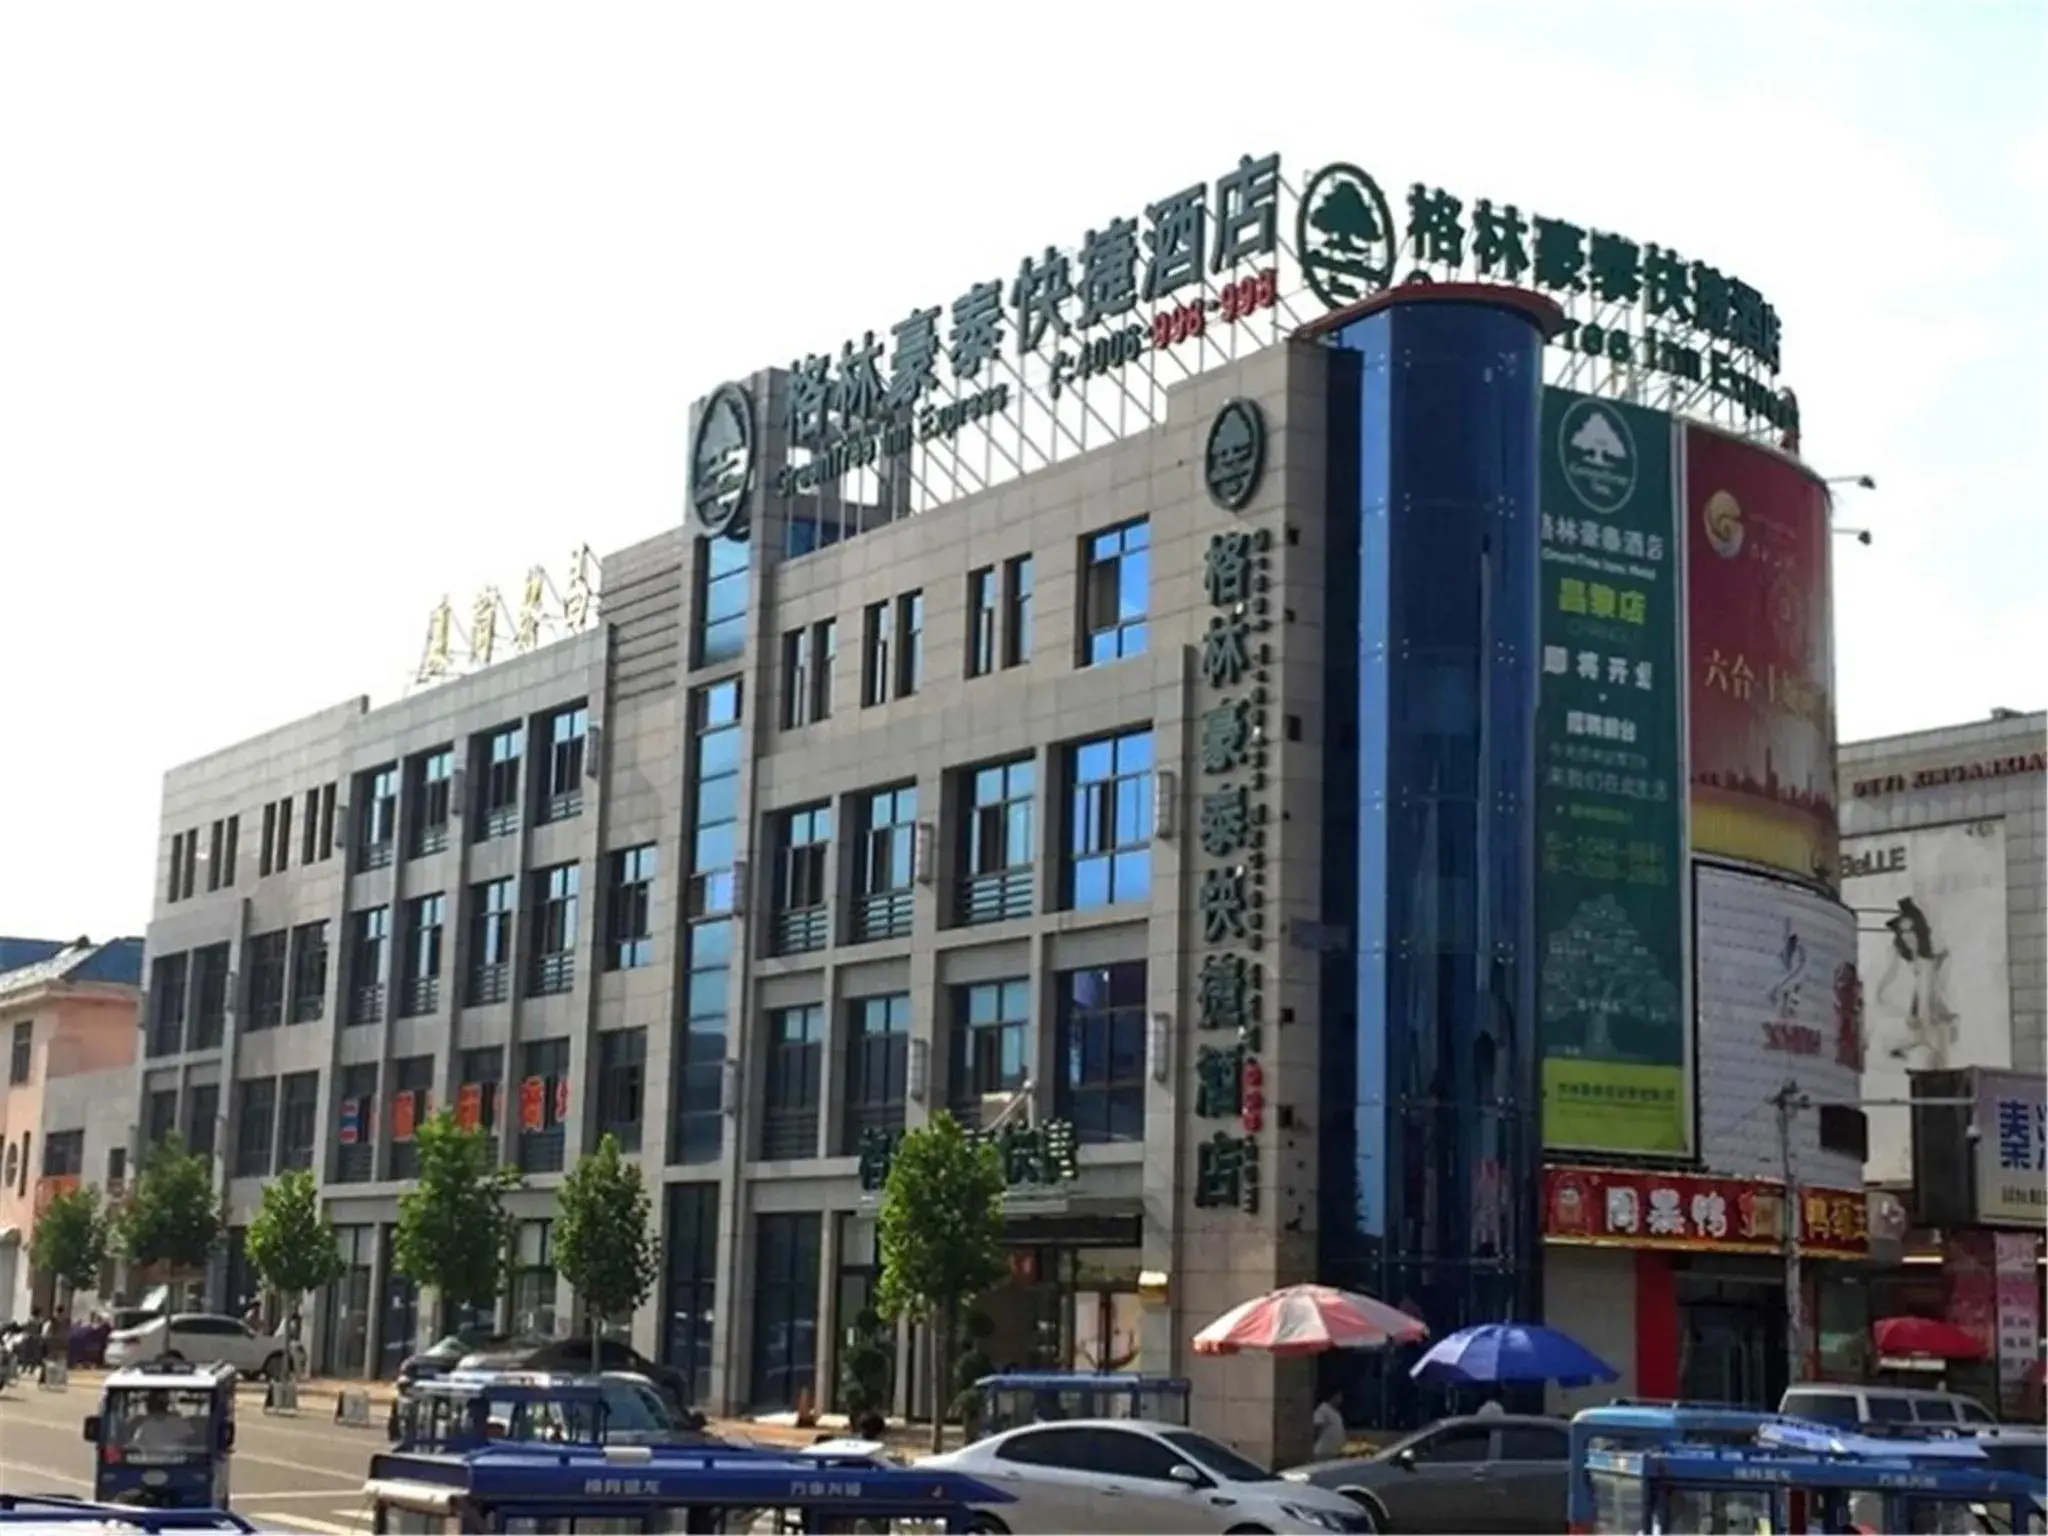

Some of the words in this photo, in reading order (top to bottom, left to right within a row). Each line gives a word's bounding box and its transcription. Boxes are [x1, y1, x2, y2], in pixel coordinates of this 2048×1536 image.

[781, 152, 1280, 444] 格林豪泰快捷酒店
